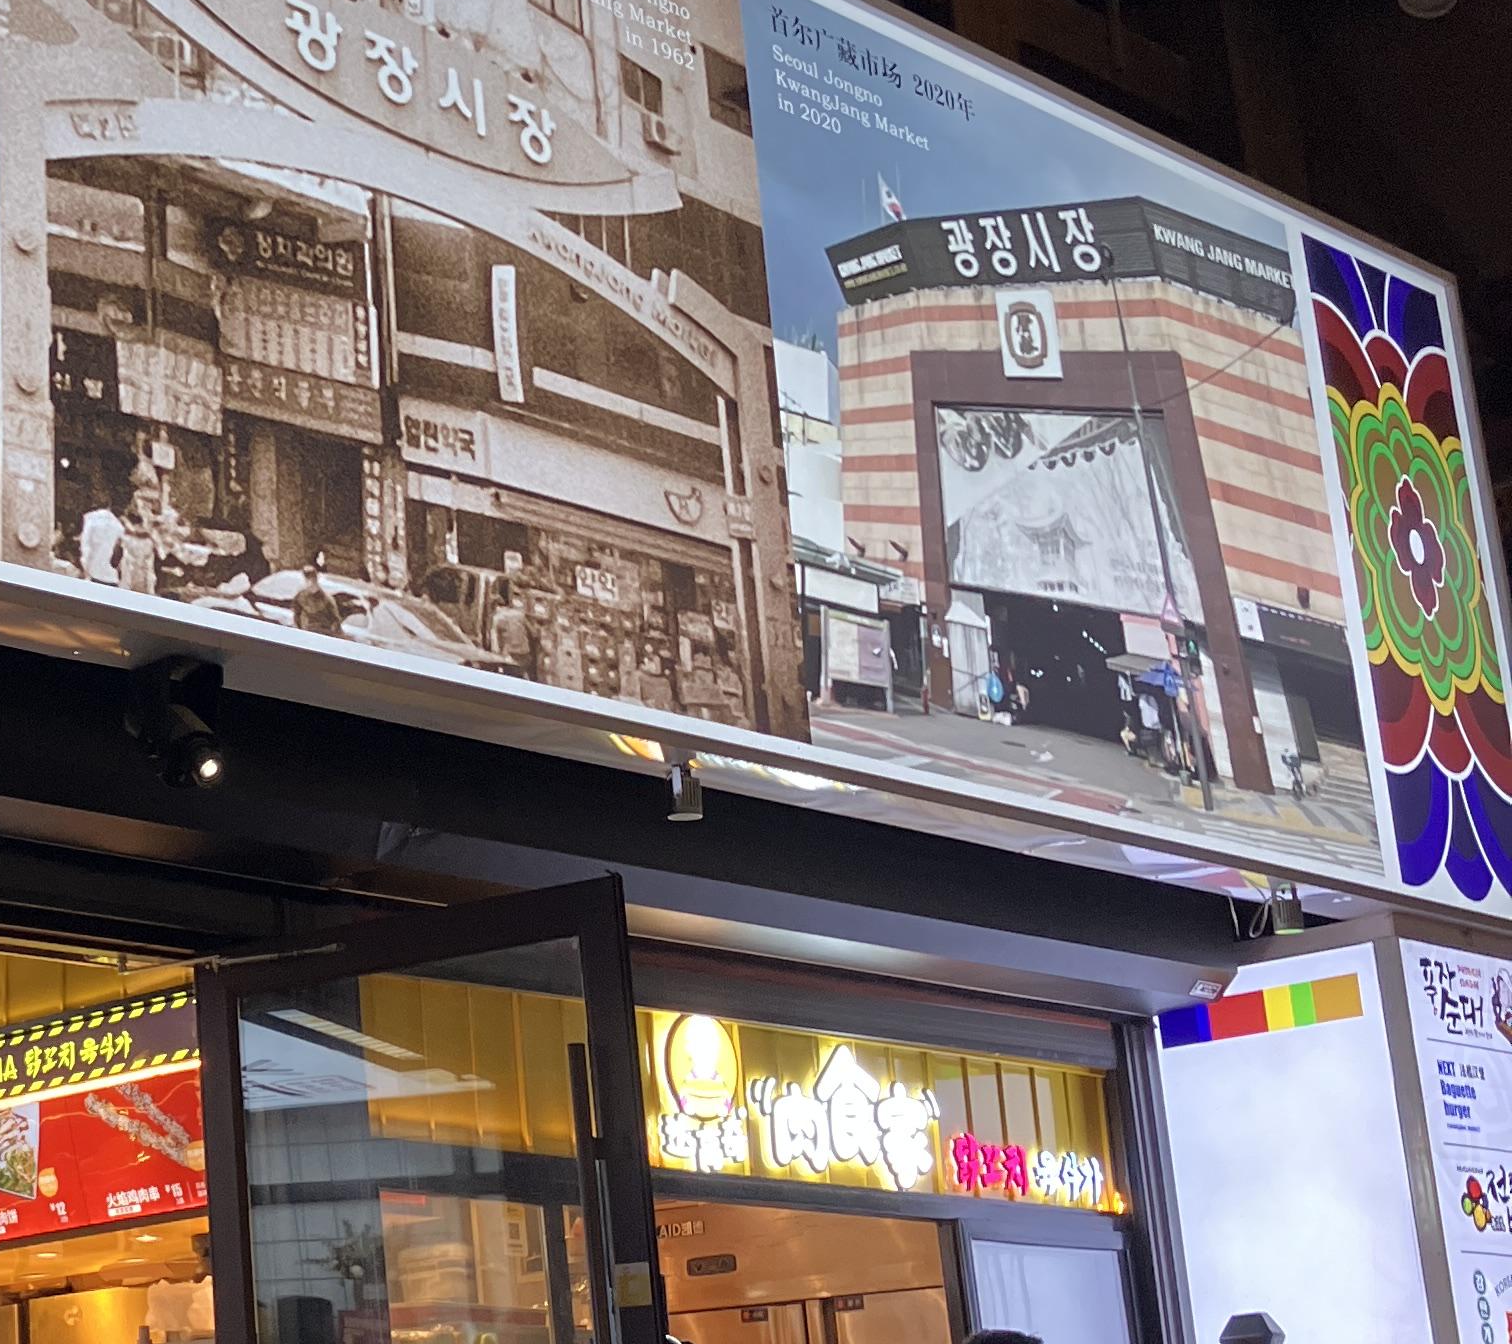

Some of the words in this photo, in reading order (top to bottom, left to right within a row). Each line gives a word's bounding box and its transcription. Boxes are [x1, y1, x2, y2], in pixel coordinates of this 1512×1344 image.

[628, 4, 694, 45] Market
[625, 28, 644, 49] in
[650, 38, 695, 71] 1962
[769, 4, 902, 89] 首尔广藏市场
[913, 73, 976, 122] 2020年
[772, 44, 818, 80] Seoul
[823, 69, 884, 108] Jongno
[774, 68, 871, 128] KwangJang
[875, 112, 930, 151] Market
[777, 93, 795, 115] in
[801, 103, 842, 134] 2020
[940, 208, 1101, 278] 광장시장
[1152, 223, 1205, 257] KWANG
[1207, 244, 1243, 271] JANG
[80, 1030, 133, 1065] 육식가
[1486, 1164, 1512, 1205] 전
